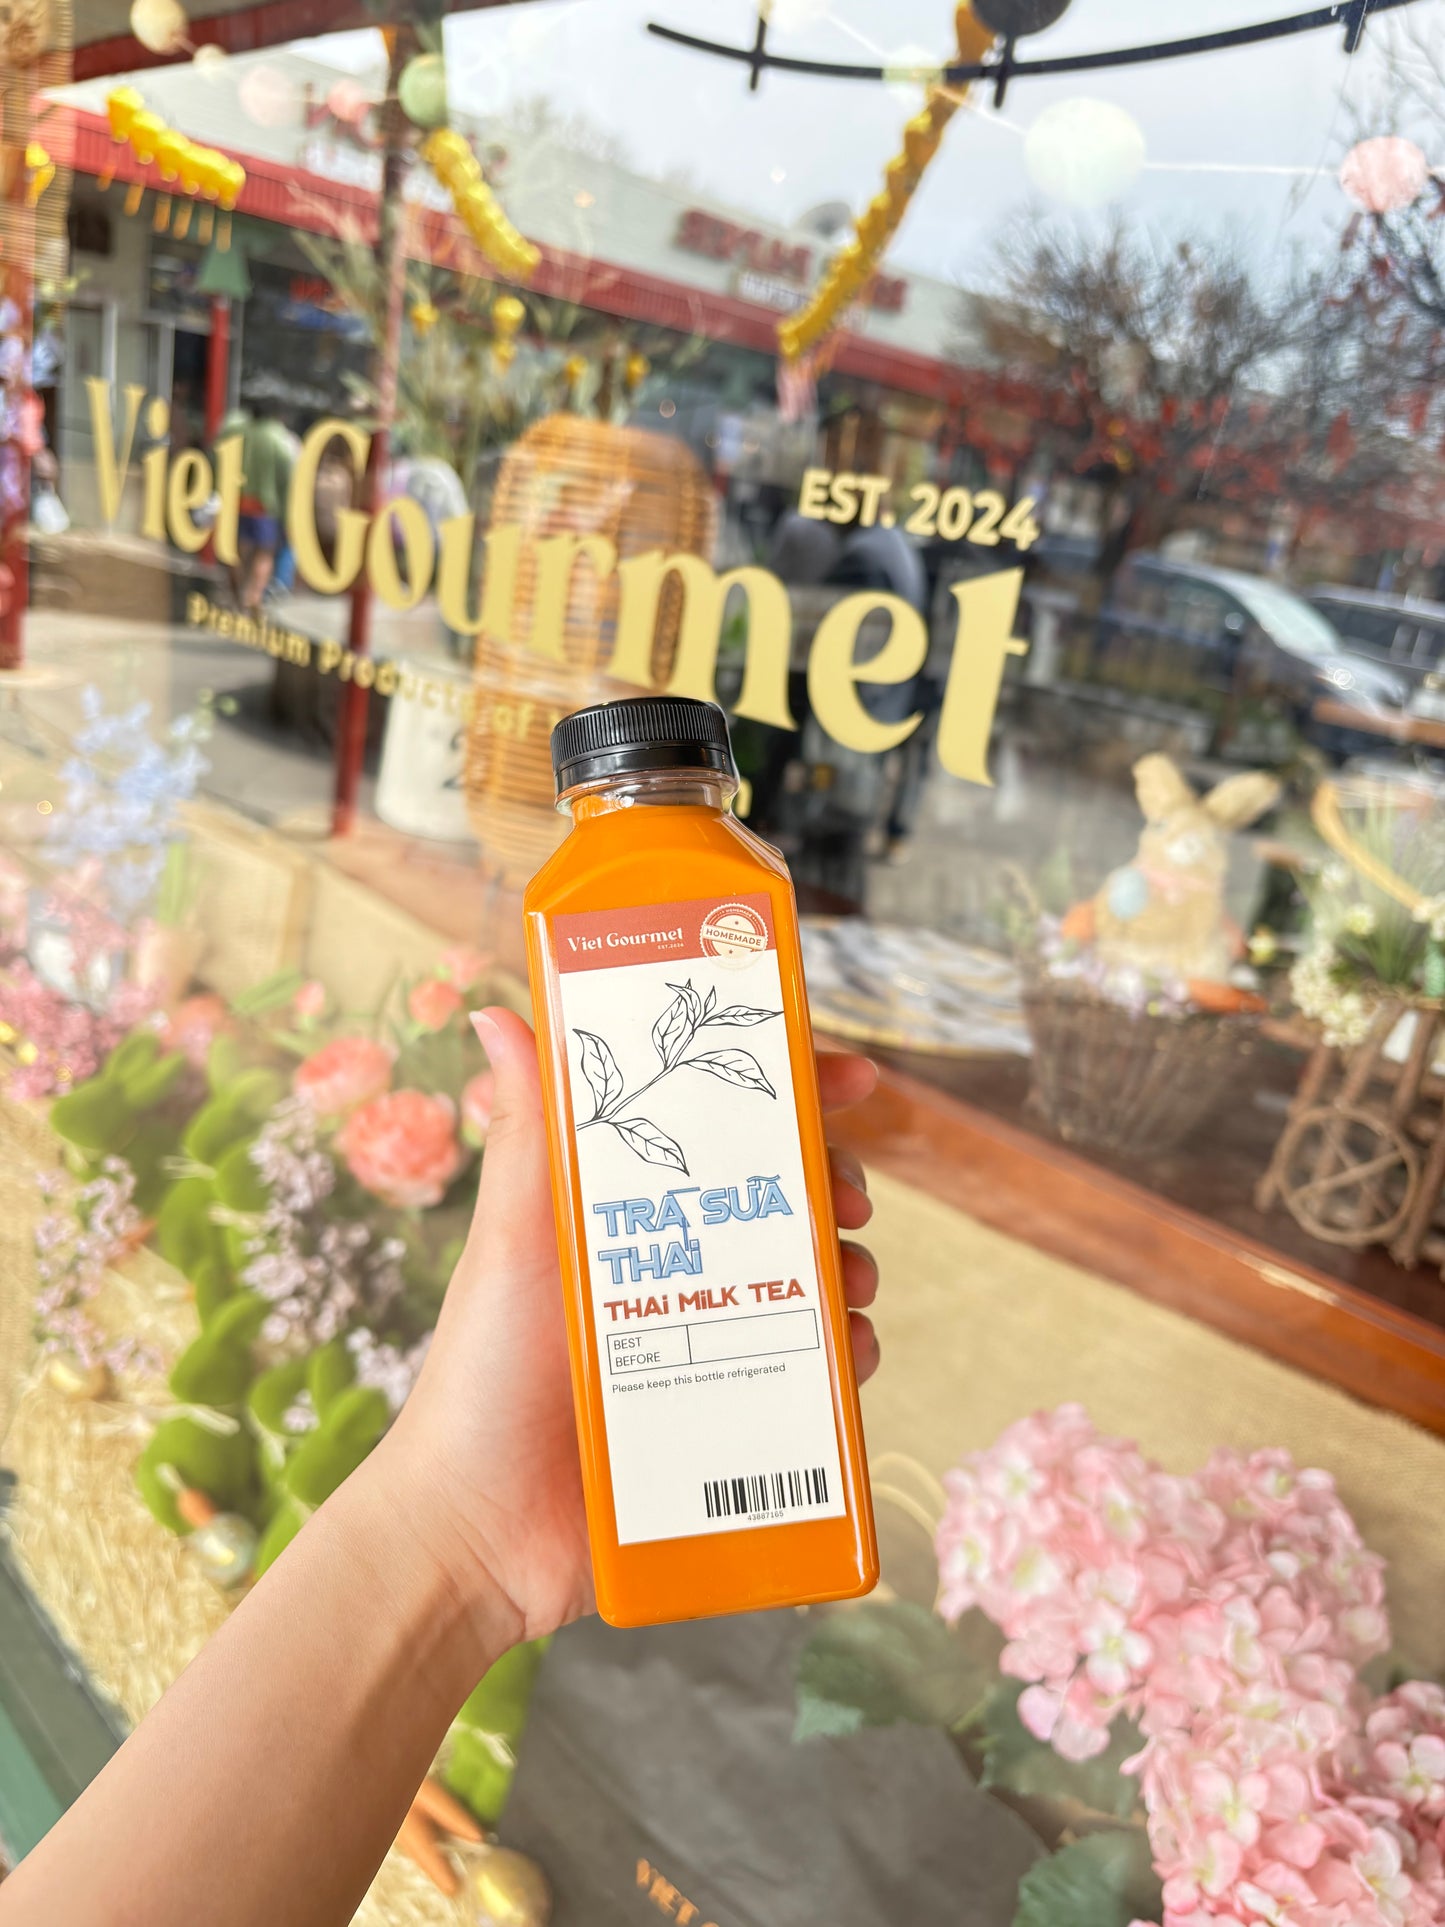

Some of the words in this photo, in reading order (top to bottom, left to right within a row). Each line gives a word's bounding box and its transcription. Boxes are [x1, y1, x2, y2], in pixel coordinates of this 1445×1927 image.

[799, 468, 896, 528] EST.
[906, 486, 1040, 552] 2024
[86, 377, 246, 567] Viet
[288, 419, 1029, 785] Gourmet
[187, 592, 312, 668] Premium
[567, 936, 603, 952] Viet
[606, 927, 684, 948] Gourmet
[705, 928, 762, 946] HOMEMADE
[747, 1278, 806, 1303] TEA
[613, 1336, 643, 1351] BEST
[615, 1352, 662, 1368] BEFORE
[612, 1382, 645, 1394] Please
[646, 1378, 672, 1389] keep
[674, 1374, 693, 1386] this
[694, 1370, 726, 1384] bottle
[726, 1362, 787, 1380] refrigerated
